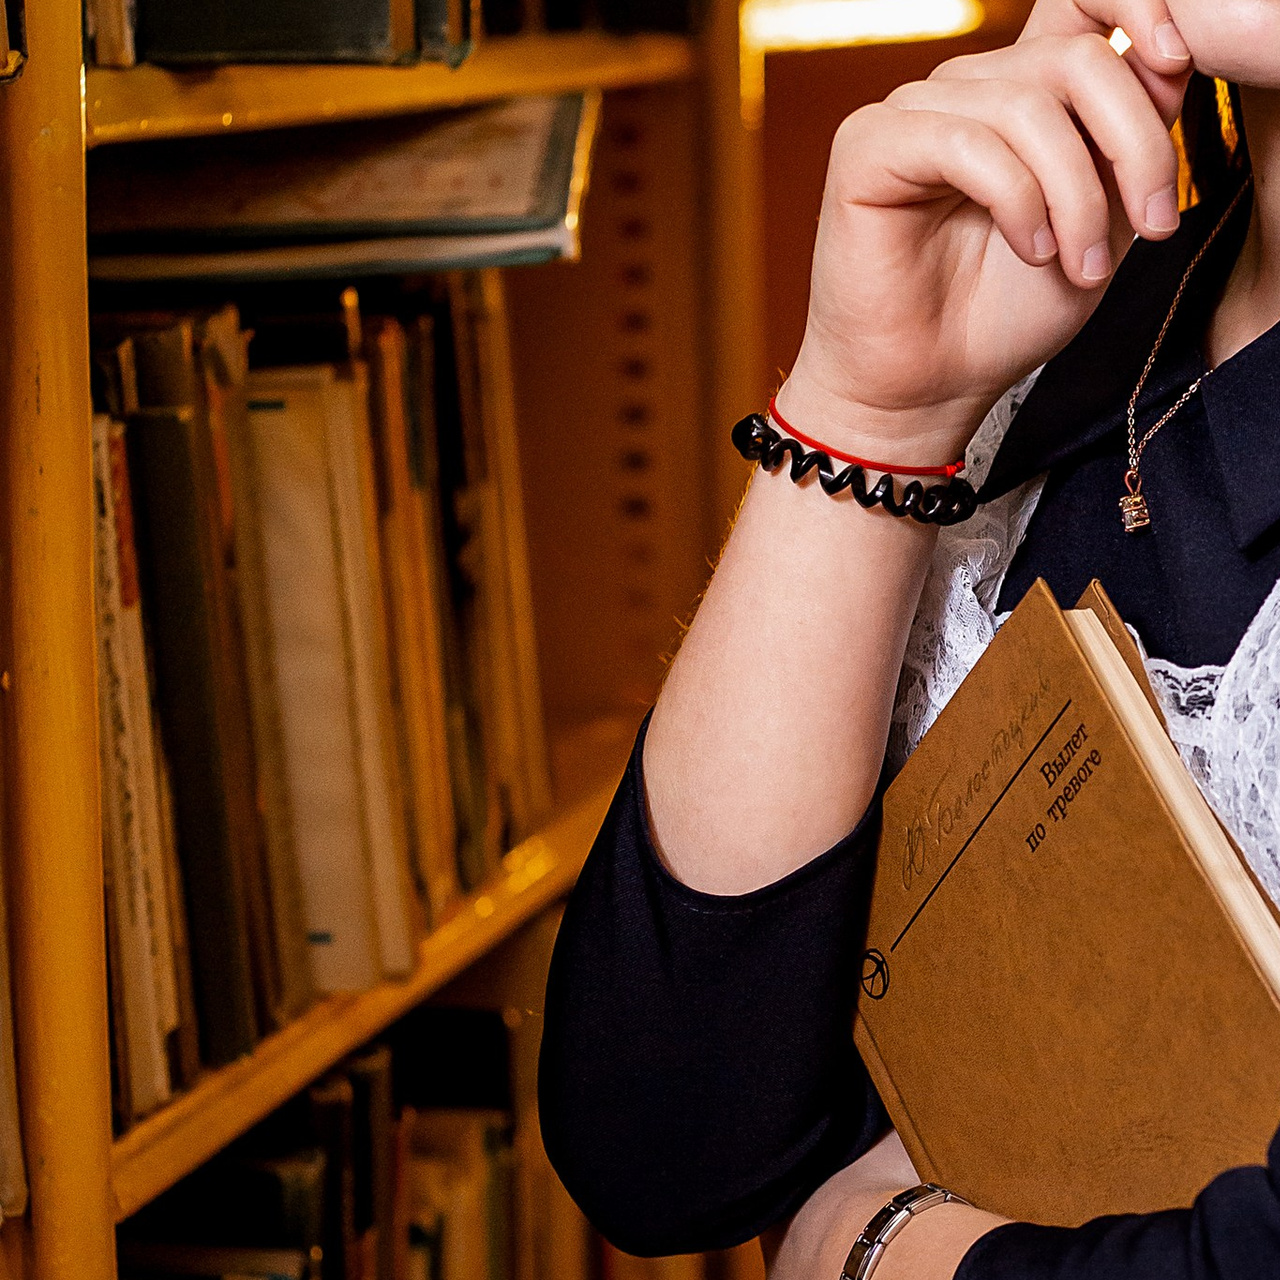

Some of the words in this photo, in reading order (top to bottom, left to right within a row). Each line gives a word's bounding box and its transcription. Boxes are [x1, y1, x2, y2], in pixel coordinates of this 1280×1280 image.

[1039, 723, 1089, 789] Вылет
[1025, 822, 1047, 853] по
[1046, 748, 1102, 822] тревоге
